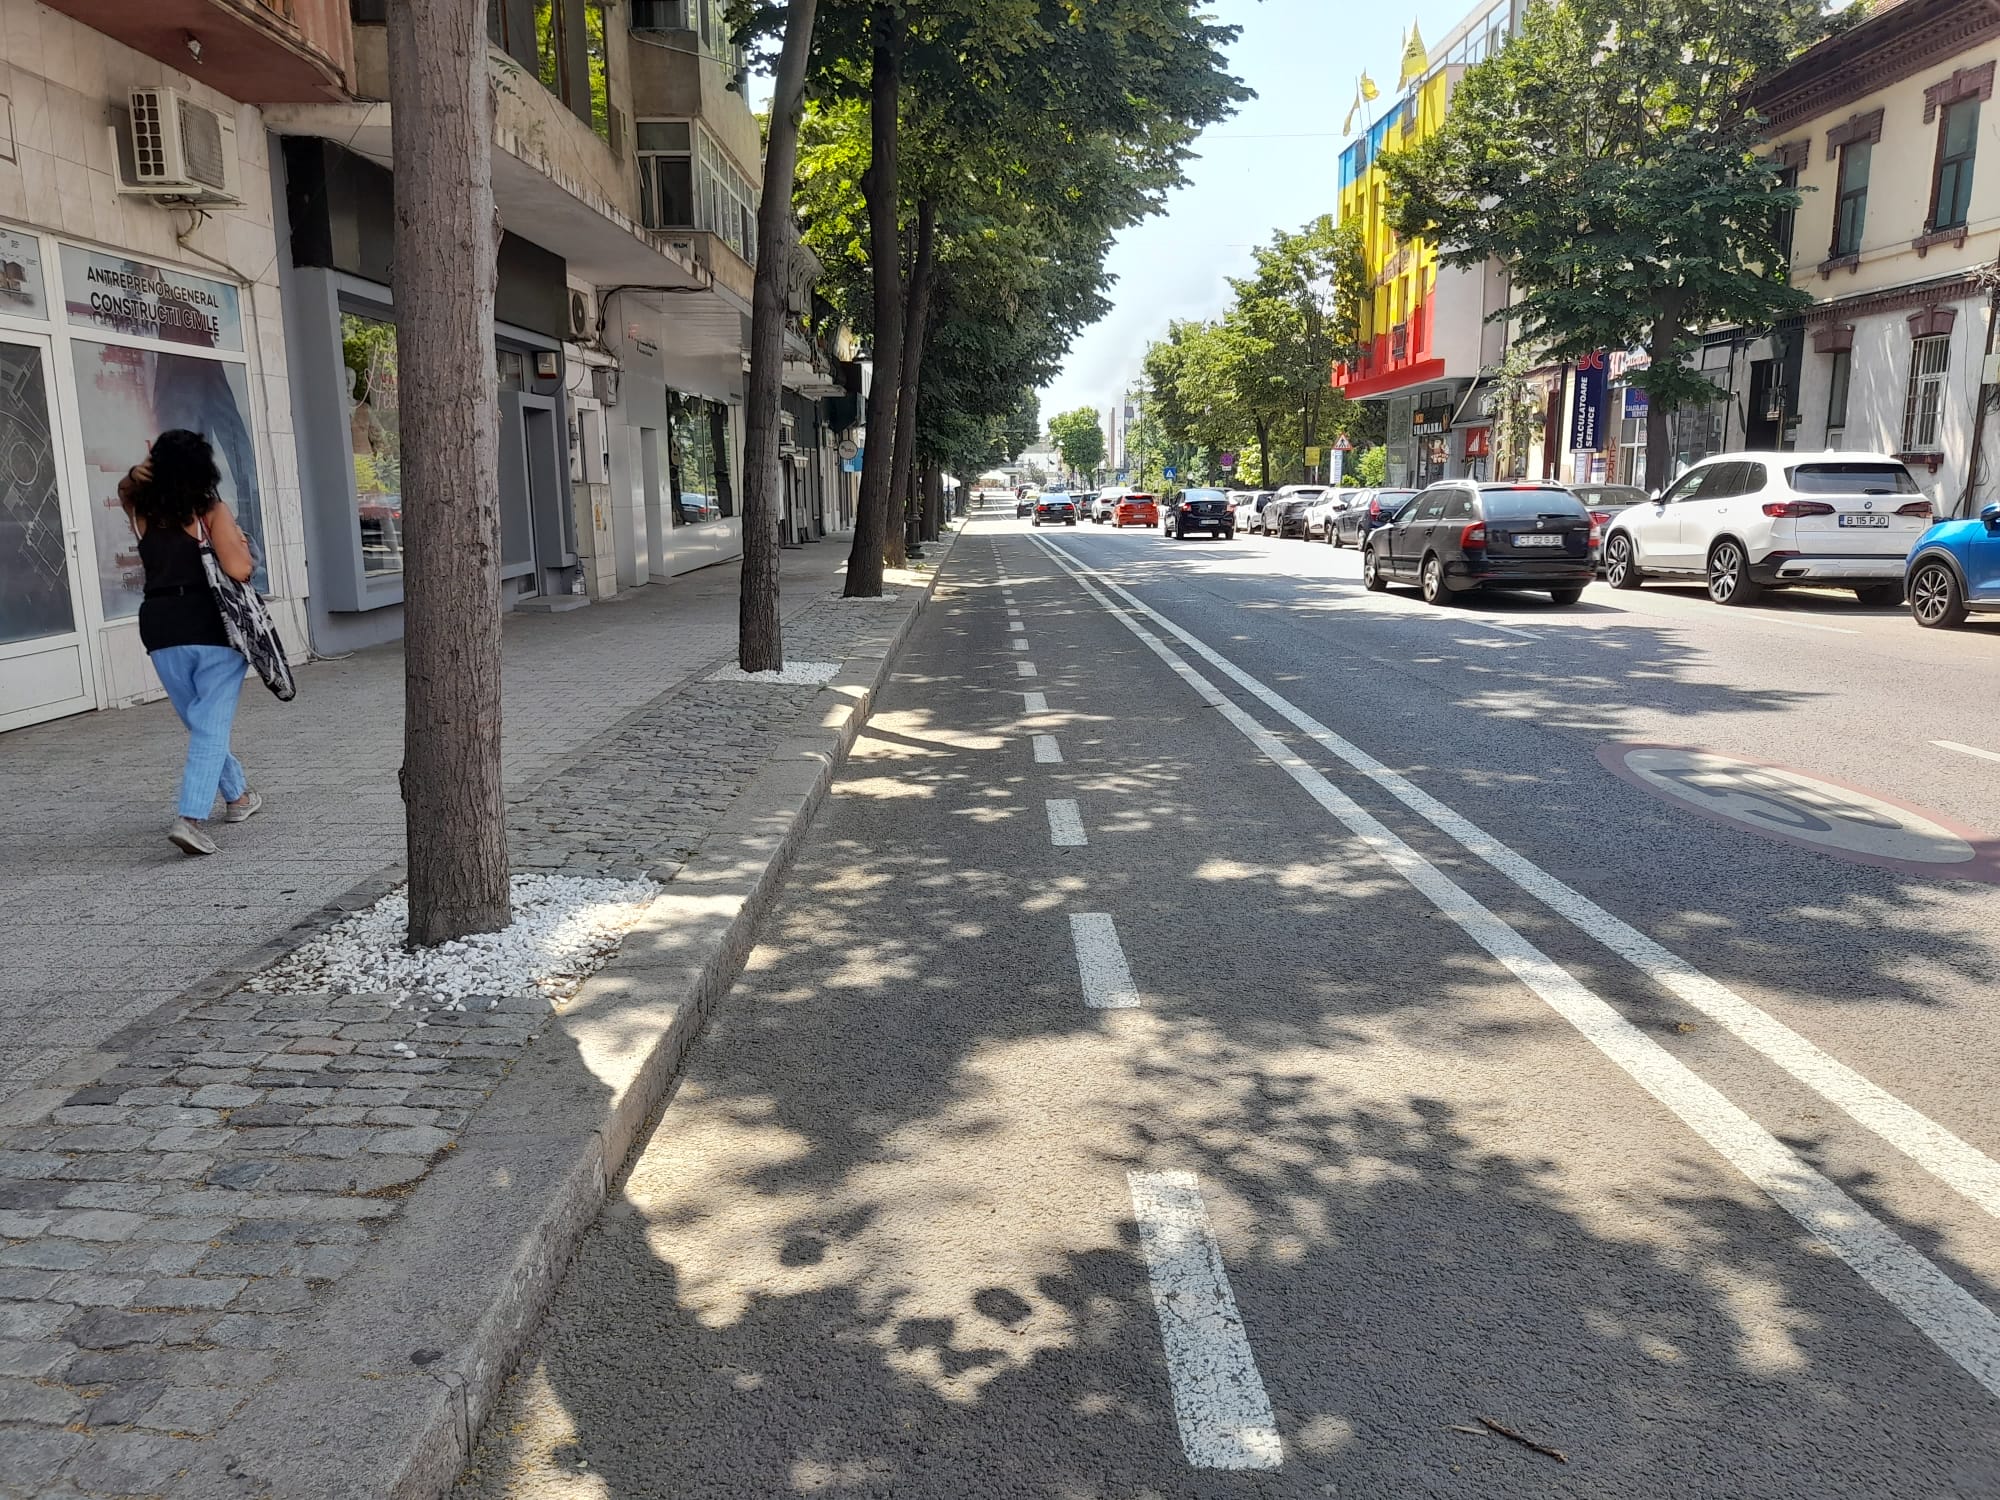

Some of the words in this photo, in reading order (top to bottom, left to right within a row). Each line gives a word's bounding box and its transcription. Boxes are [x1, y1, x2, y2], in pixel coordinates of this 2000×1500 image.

[87, 266, 171, 299] ANTREPRENOR
[174, 286, 219, 308] GENERAL
[91, 291, 181, 326] CONSTRUCTII
[183, 309, 219, 332] CIVILE
[1576, 376, 1588, 449] CALCULATOARE
[1585, 406, 1596, 447] SERVICE
[1846, 516, 1854, 525] B
[1856, 516, 1867, 525] 115
[1869, 516, 1886, 525] PJO
